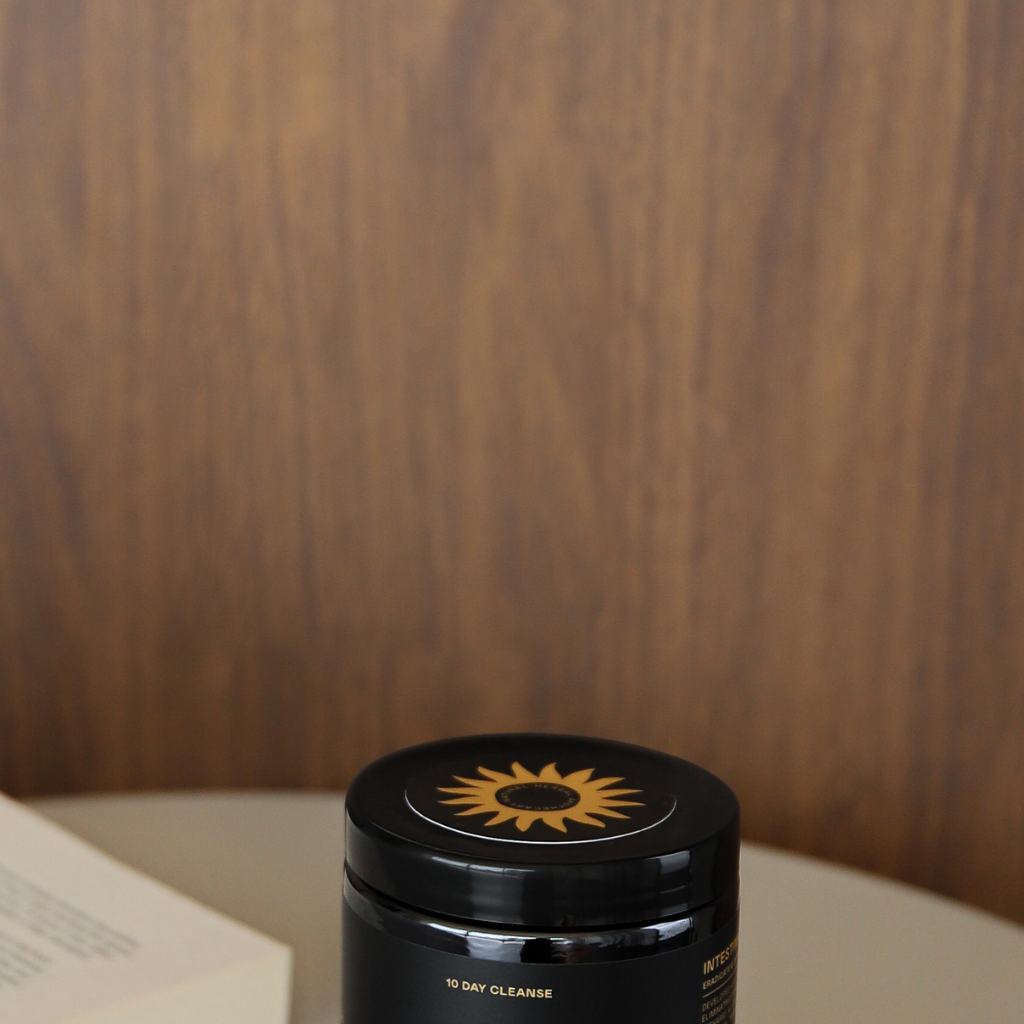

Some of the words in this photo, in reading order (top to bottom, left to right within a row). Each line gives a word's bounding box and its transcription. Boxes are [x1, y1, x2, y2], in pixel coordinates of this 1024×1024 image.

[446, 978, 459, 988] 10
[462, 980, 486, 994] DAY
[490, 985, 553, 999] CLEANSE
